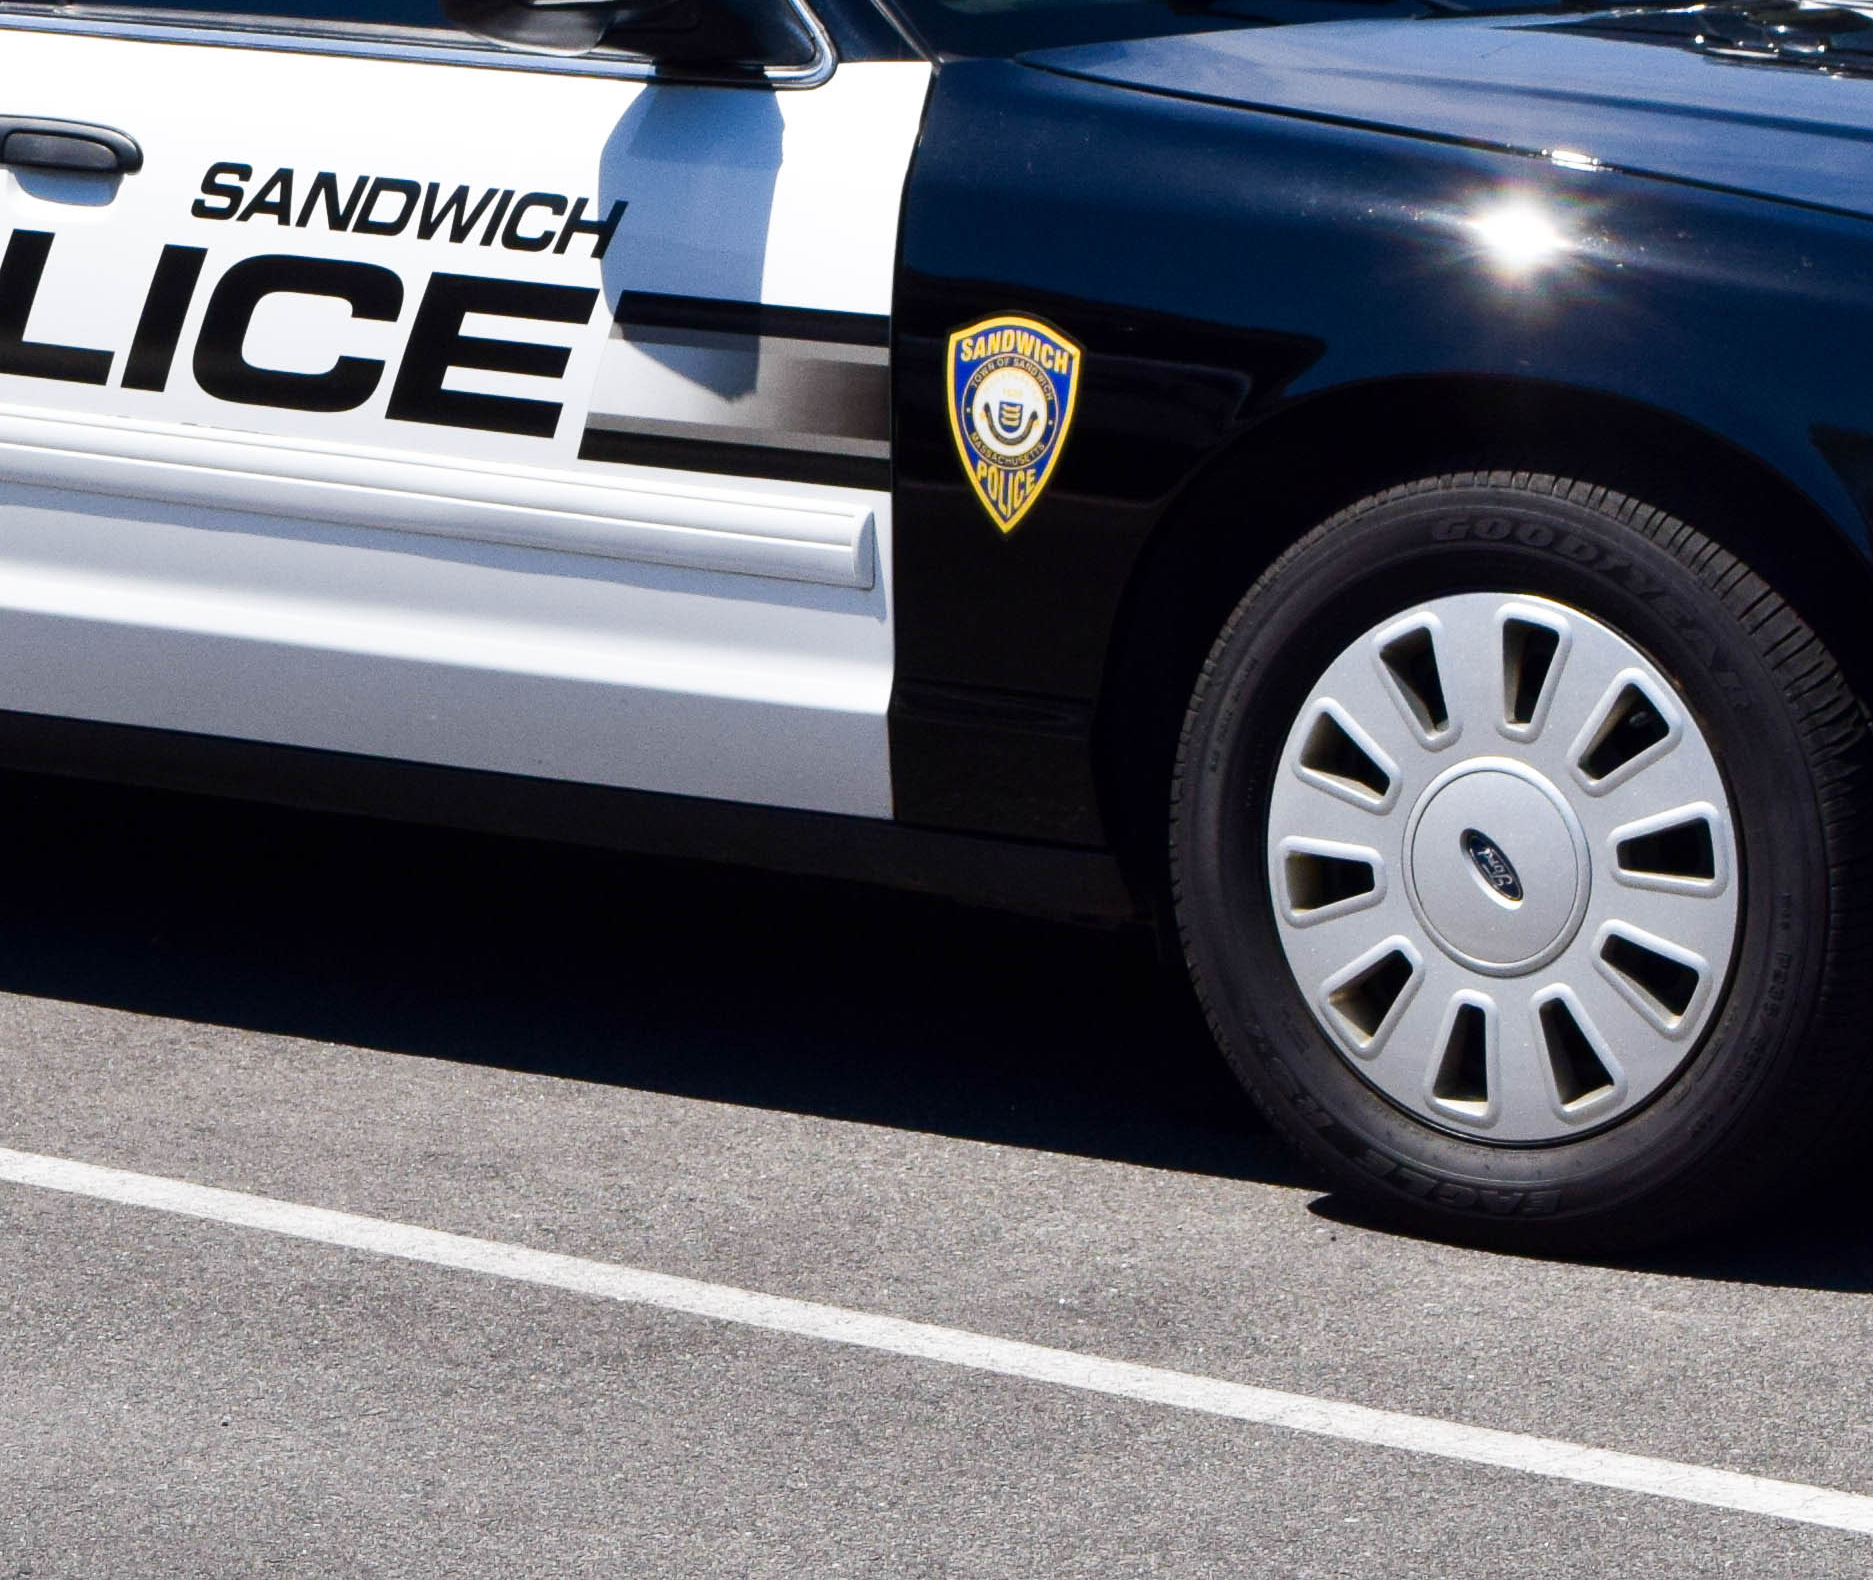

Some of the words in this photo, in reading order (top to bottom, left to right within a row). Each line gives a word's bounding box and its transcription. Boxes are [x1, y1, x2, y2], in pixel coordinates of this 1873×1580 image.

[191, 162, 629, 260] SANDWICH
[960, 329, 1069, 374] SANDWICH
[970, 361, 996, 389] TOWN
[1012, 358, 1054, 401] SANDWICH
[970, 431, 1047, 466] MASSACHUSETTS
[976, 459, 1038, 519] POLICE
